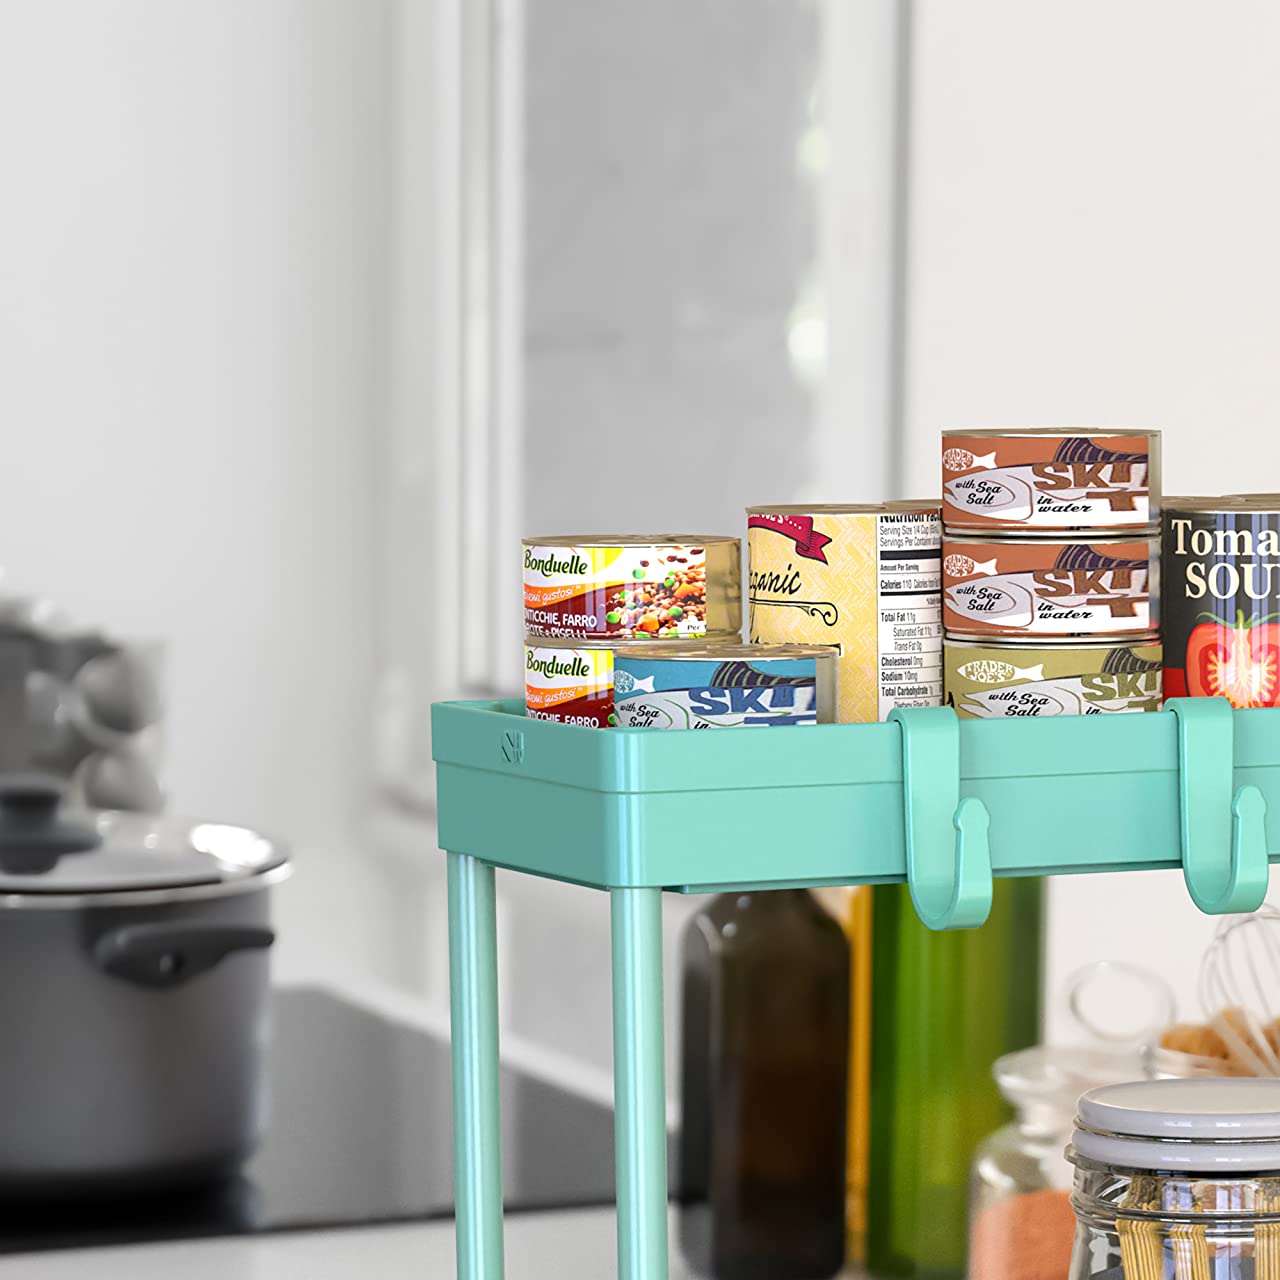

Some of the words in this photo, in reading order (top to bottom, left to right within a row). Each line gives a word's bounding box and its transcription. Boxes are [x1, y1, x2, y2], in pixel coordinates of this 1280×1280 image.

[955, 479, 976, 489] with
[976, 481, 1002, 493] Sea
[966, 492, 995, 505] Salt
[1037, 495, 1055, 505] in
[1038, 503, 1093, 513] water
[525, 549, 588, 577] Bonduelle
[956, 585, 977, 595] with
[976, 587, 1002, 599] Sea
[967, 599, 995, 611] Salt
[1037, 602, 1055, 611] in
[563, 614, 597, 628] FARRO
[881, 612, 896, 622] Total
[897, 612, 906, 622] Fat
[1039, 610, 1094, 619] water
[526, 650, 590, 678] Bonduelle
[966, 660, 1014, 673] TRADER
[970, 671, 1006, 682] JOE'S
[988, 691, 1019, 700] with
[1018, 693, 1050, 705] Sea
[620, 703, 638, 713] with
[636, 705, 660, 717] Sea
[1005, 704, 1041, 716] Salt
